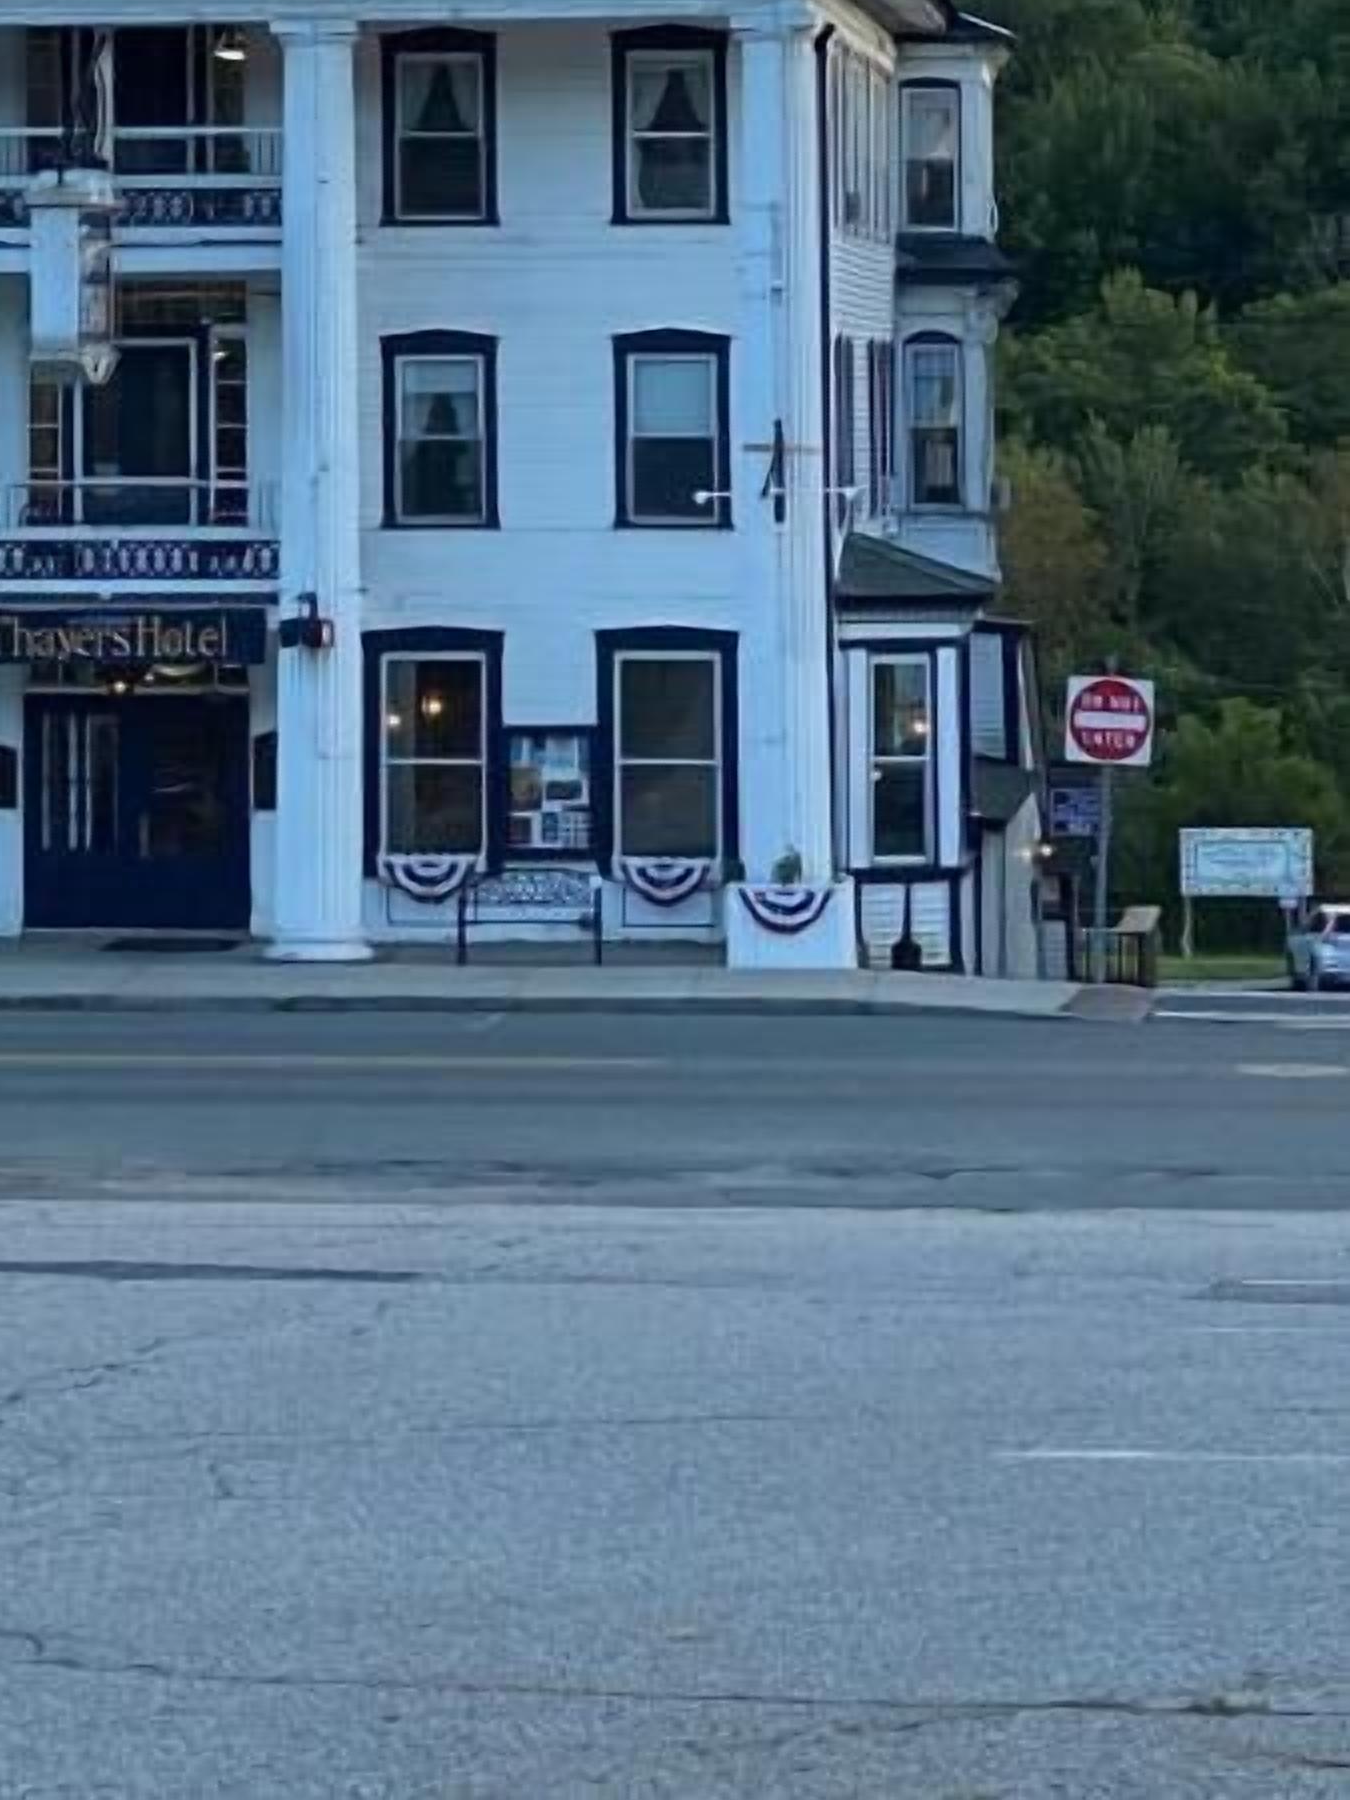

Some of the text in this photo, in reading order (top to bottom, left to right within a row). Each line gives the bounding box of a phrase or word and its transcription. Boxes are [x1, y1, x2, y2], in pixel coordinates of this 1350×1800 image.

[136, 614, 227, 658] Hotel
[1080, 692, 1140, 712] DO NOT
[1081, 730, 1136, 749] ENTER
